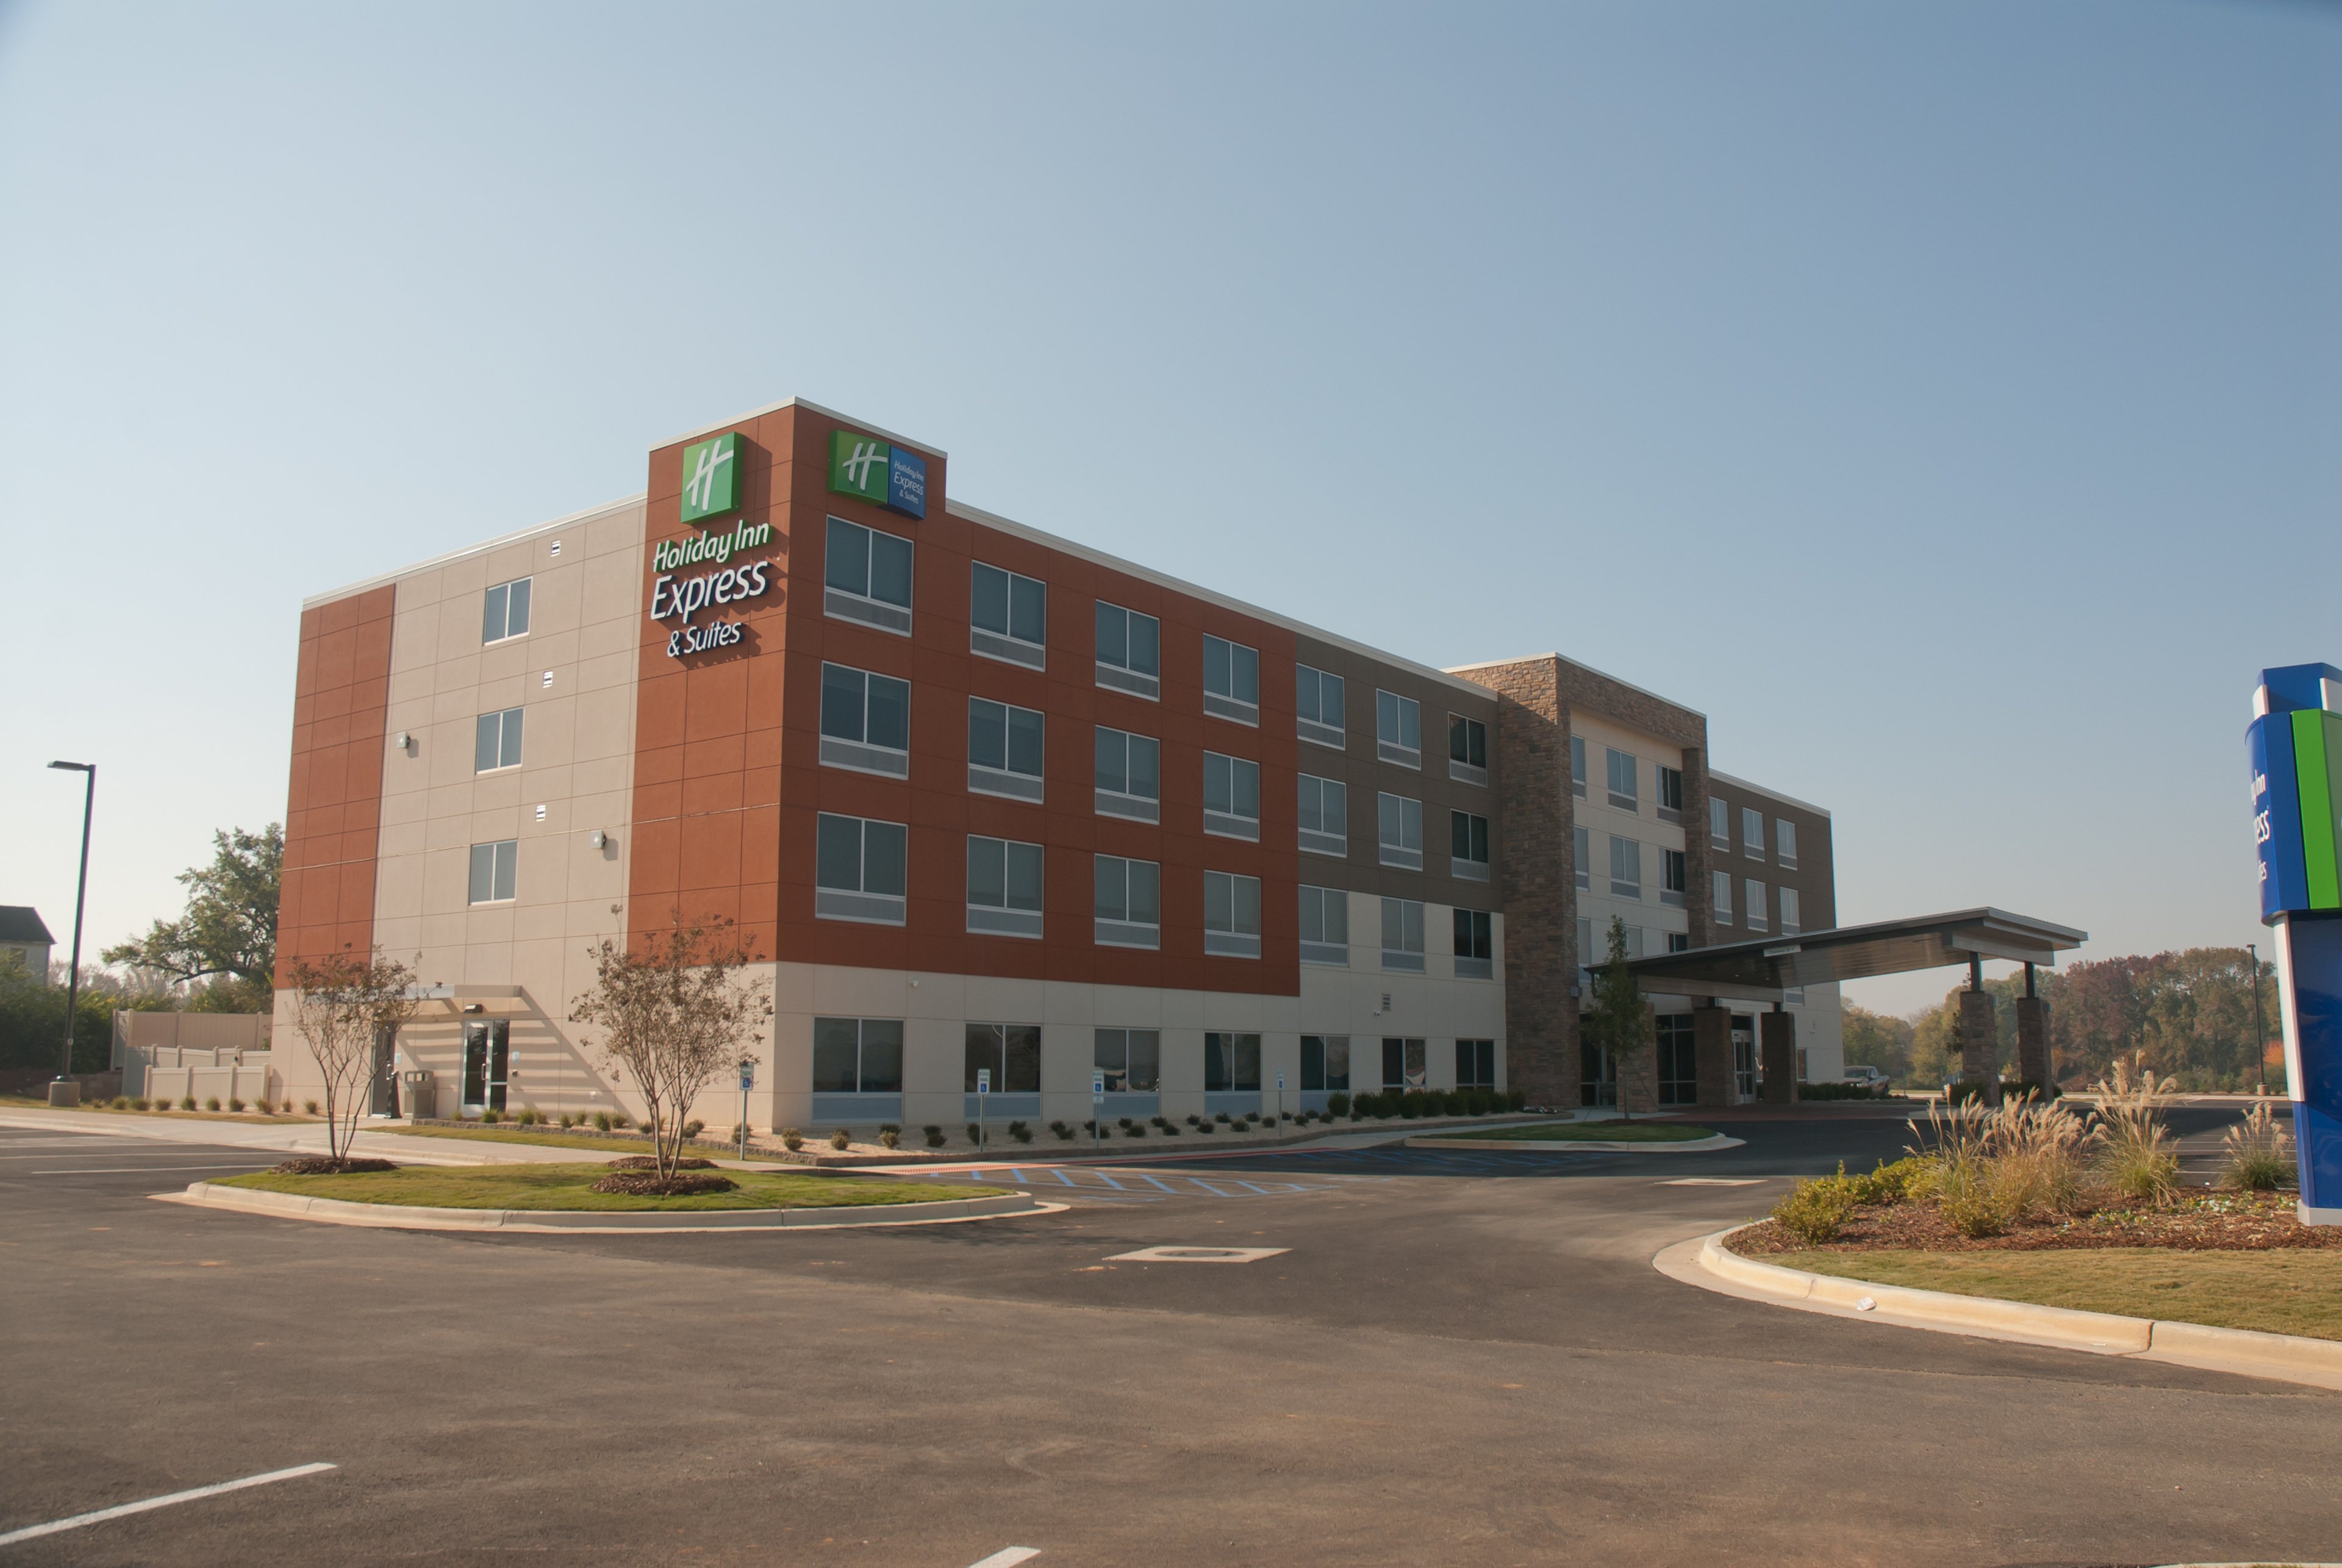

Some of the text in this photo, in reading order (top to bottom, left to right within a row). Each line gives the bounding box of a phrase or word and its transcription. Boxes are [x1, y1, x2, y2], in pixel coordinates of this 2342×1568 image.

[893, 471, 923, 495] Express
[894, 460, 916, 479] Holiday
[904, 491, 919, 504] Suites
[653, 519, 769, 573] Holiday Inn
[650, 560, 768, 624] Express
[667, 620, 742, 657] & Suites
